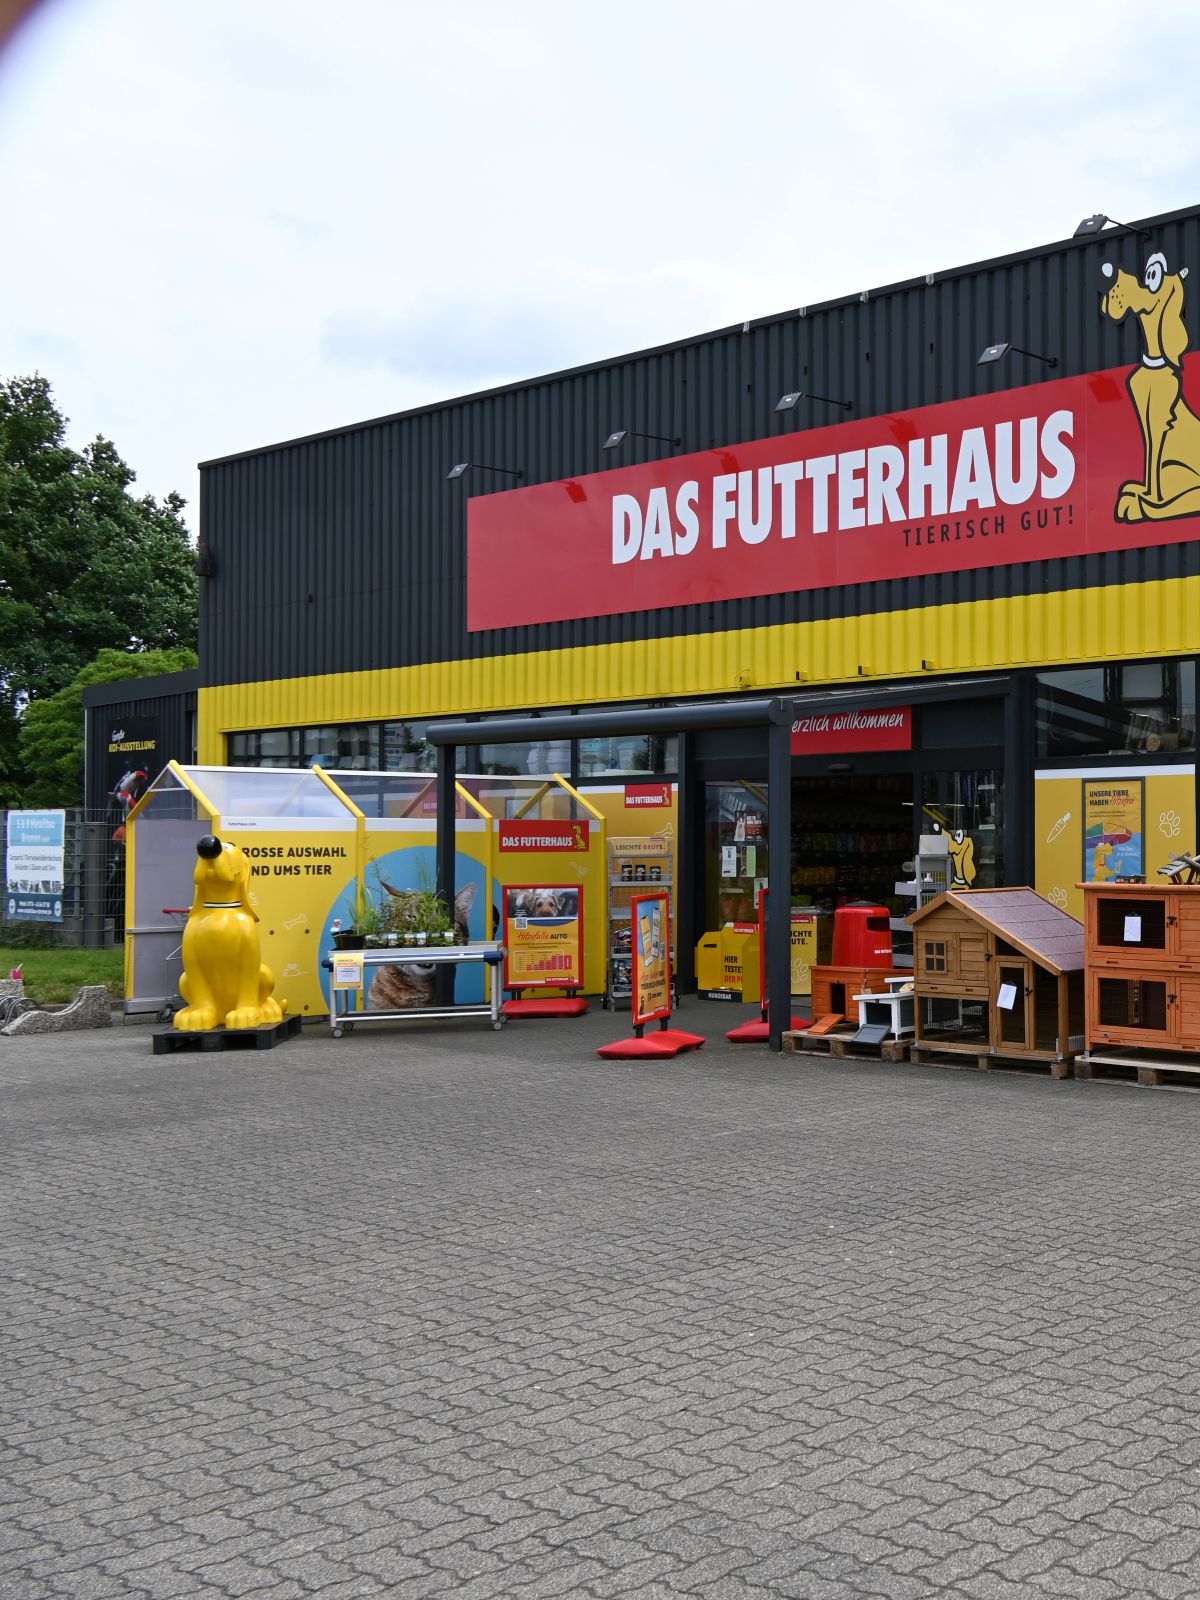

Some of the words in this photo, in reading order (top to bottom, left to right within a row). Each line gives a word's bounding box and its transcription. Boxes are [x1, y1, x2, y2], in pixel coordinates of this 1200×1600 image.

[612, 480, 699, 565] DAS
[712, 409, 1076, 549] FUTTERHAUS
[903, 515, 1006, 547] TIERISCH
[1021, 504, 1075, 532] GUT!
[791, 715, 829, 733] erzlich
[833, 709, 904, 730] willkommen
[1089, 790, 1112, 798] UNSERE
[1113, 789, 1129, 797] TIERE
[625, 796, 635, 804] DAS
[635, 795, 663, 804] FUTTERHAUS
[502, 836, 519, 847] DAS
[520, 836, 573, 847] FUTTERHAUS
[241, 847, 284, 858] ROSSE
[287, 846, 347, 858] AUSWAHL
[251, 865, 270, 876] ND
[273, 865, 301, 876] UMS
[304, 864, 332, 875] TIER
[790, 930, 813, 938] ICHTE
[724, 955, 738, 963] HIER
[724, 975, 736, 983] DER
